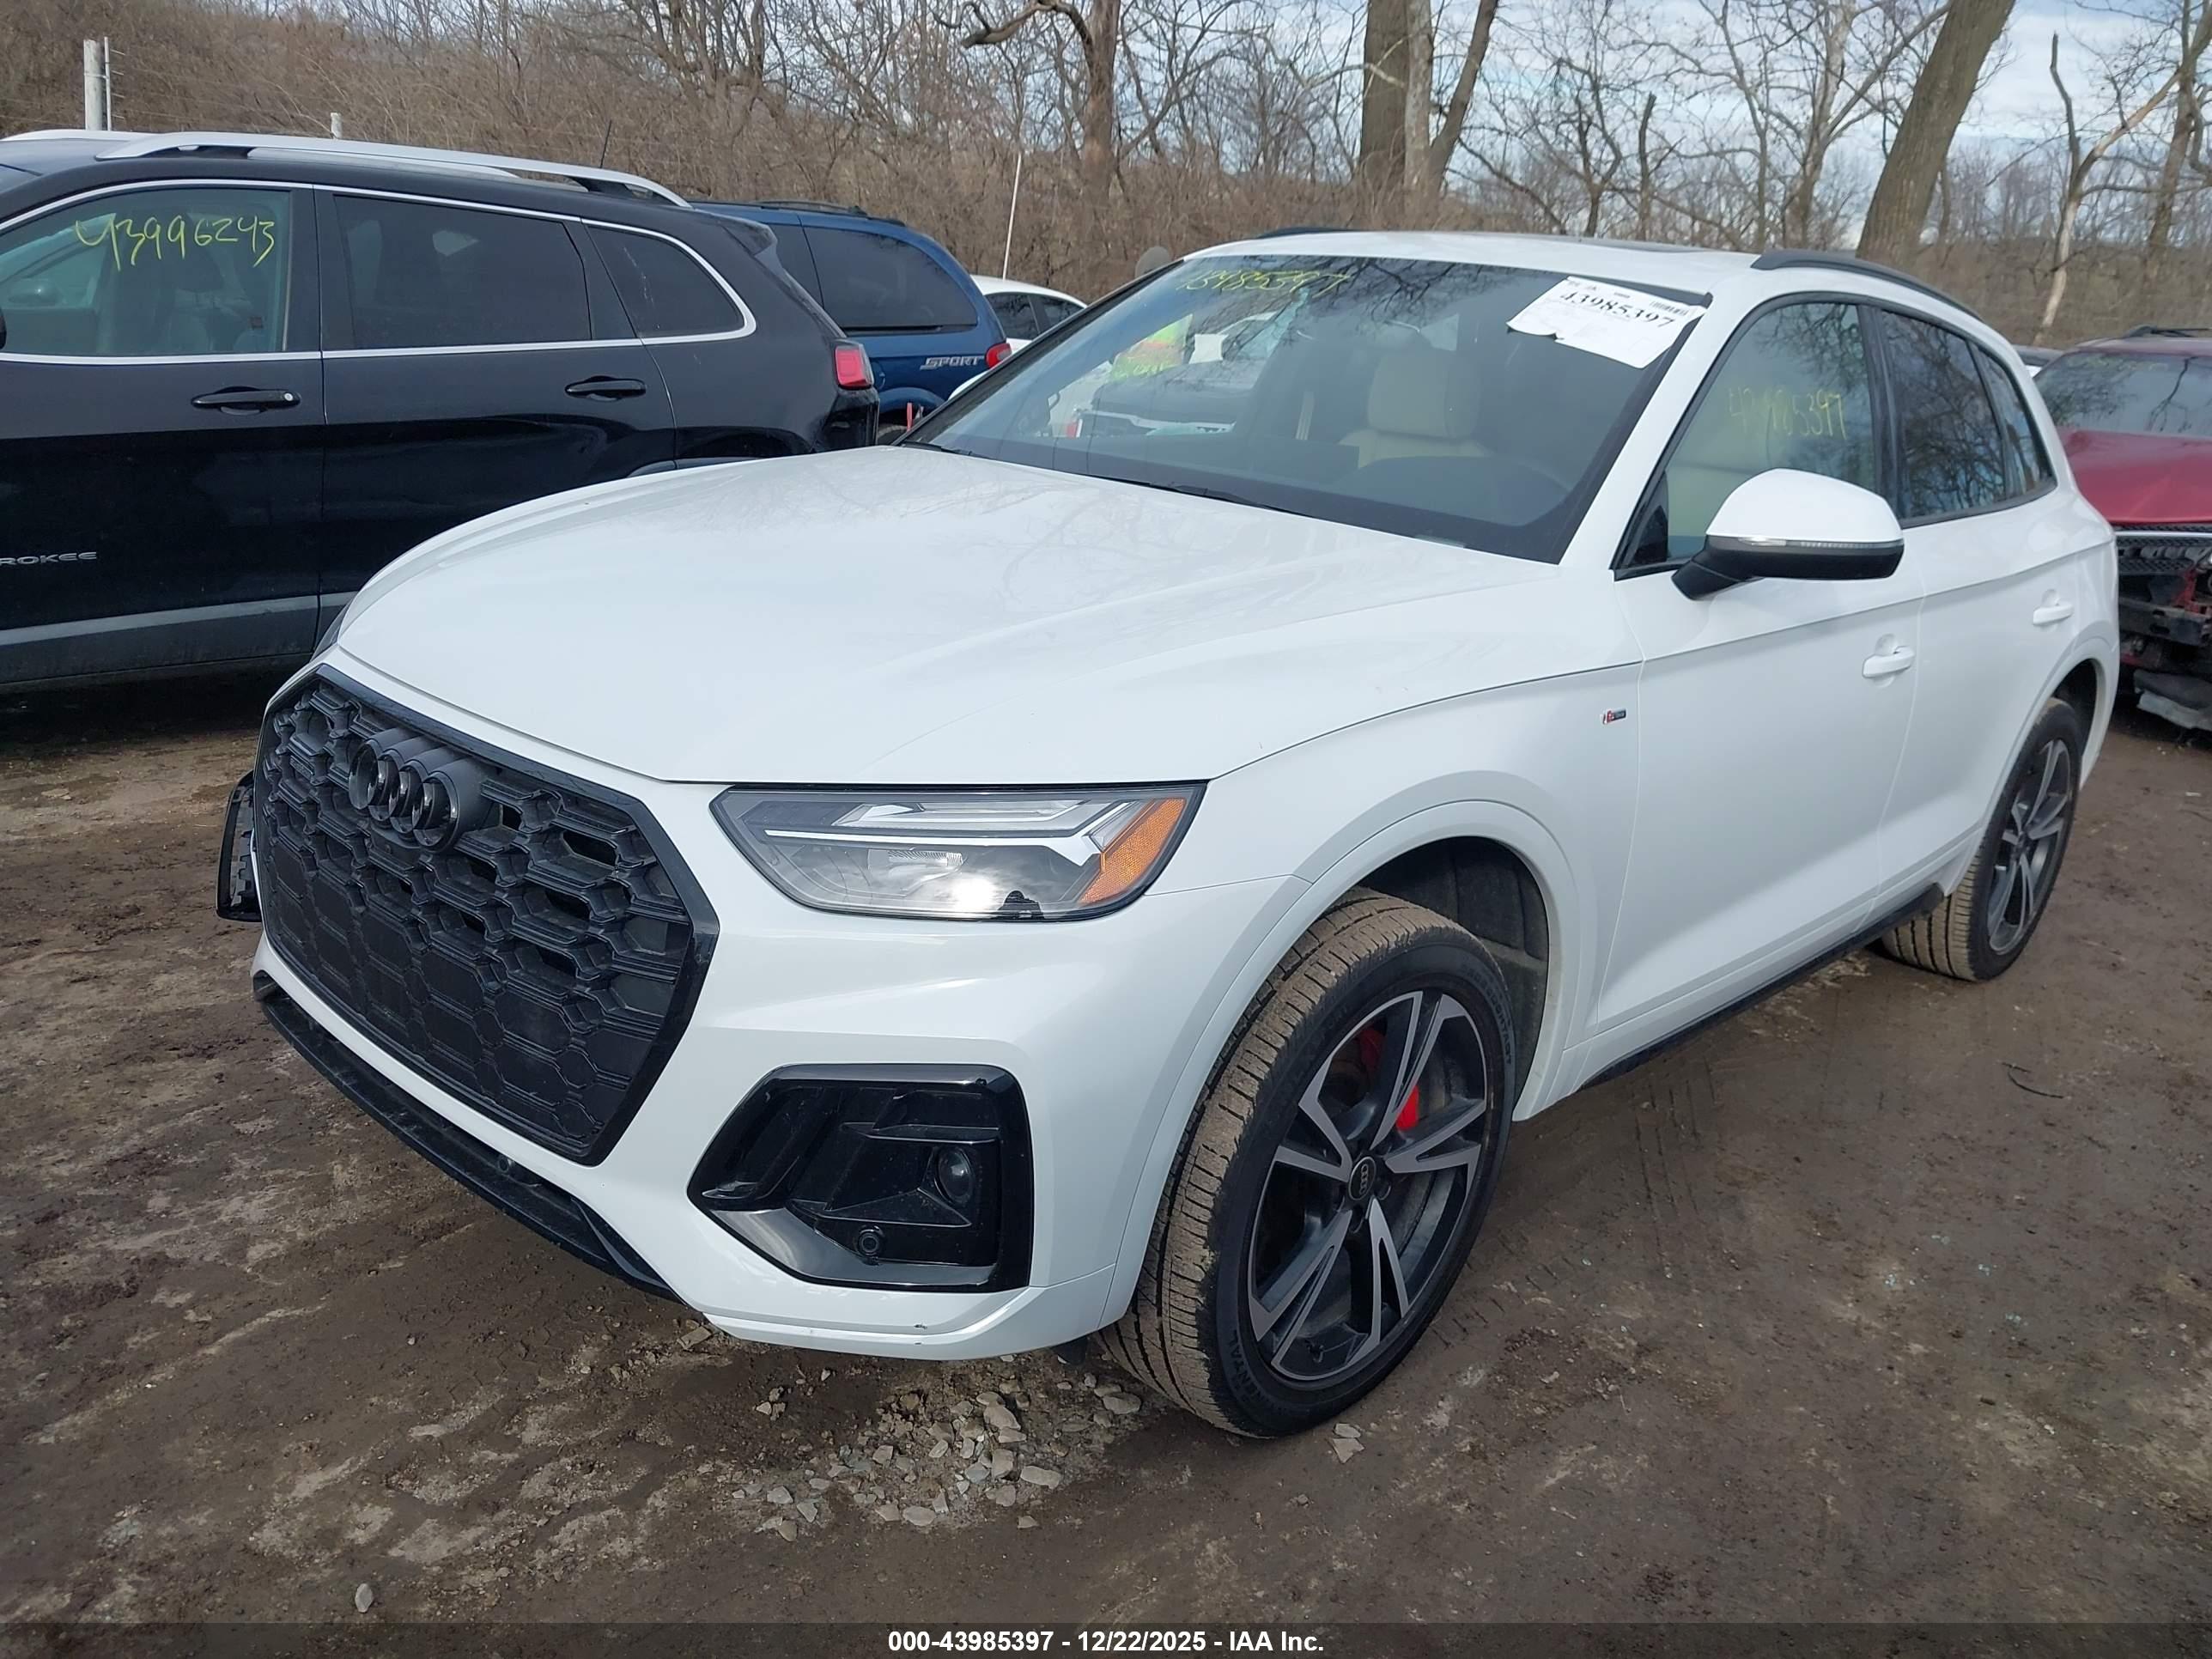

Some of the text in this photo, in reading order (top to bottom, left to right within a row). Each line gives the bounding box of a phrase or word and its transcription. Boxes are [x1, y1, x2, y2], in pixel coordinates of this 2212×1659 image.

[76, 213, 276, 271] 43996243
[1559, 290, 1675, 328] 43985397
[920, 355, 985, 371] SPORT
